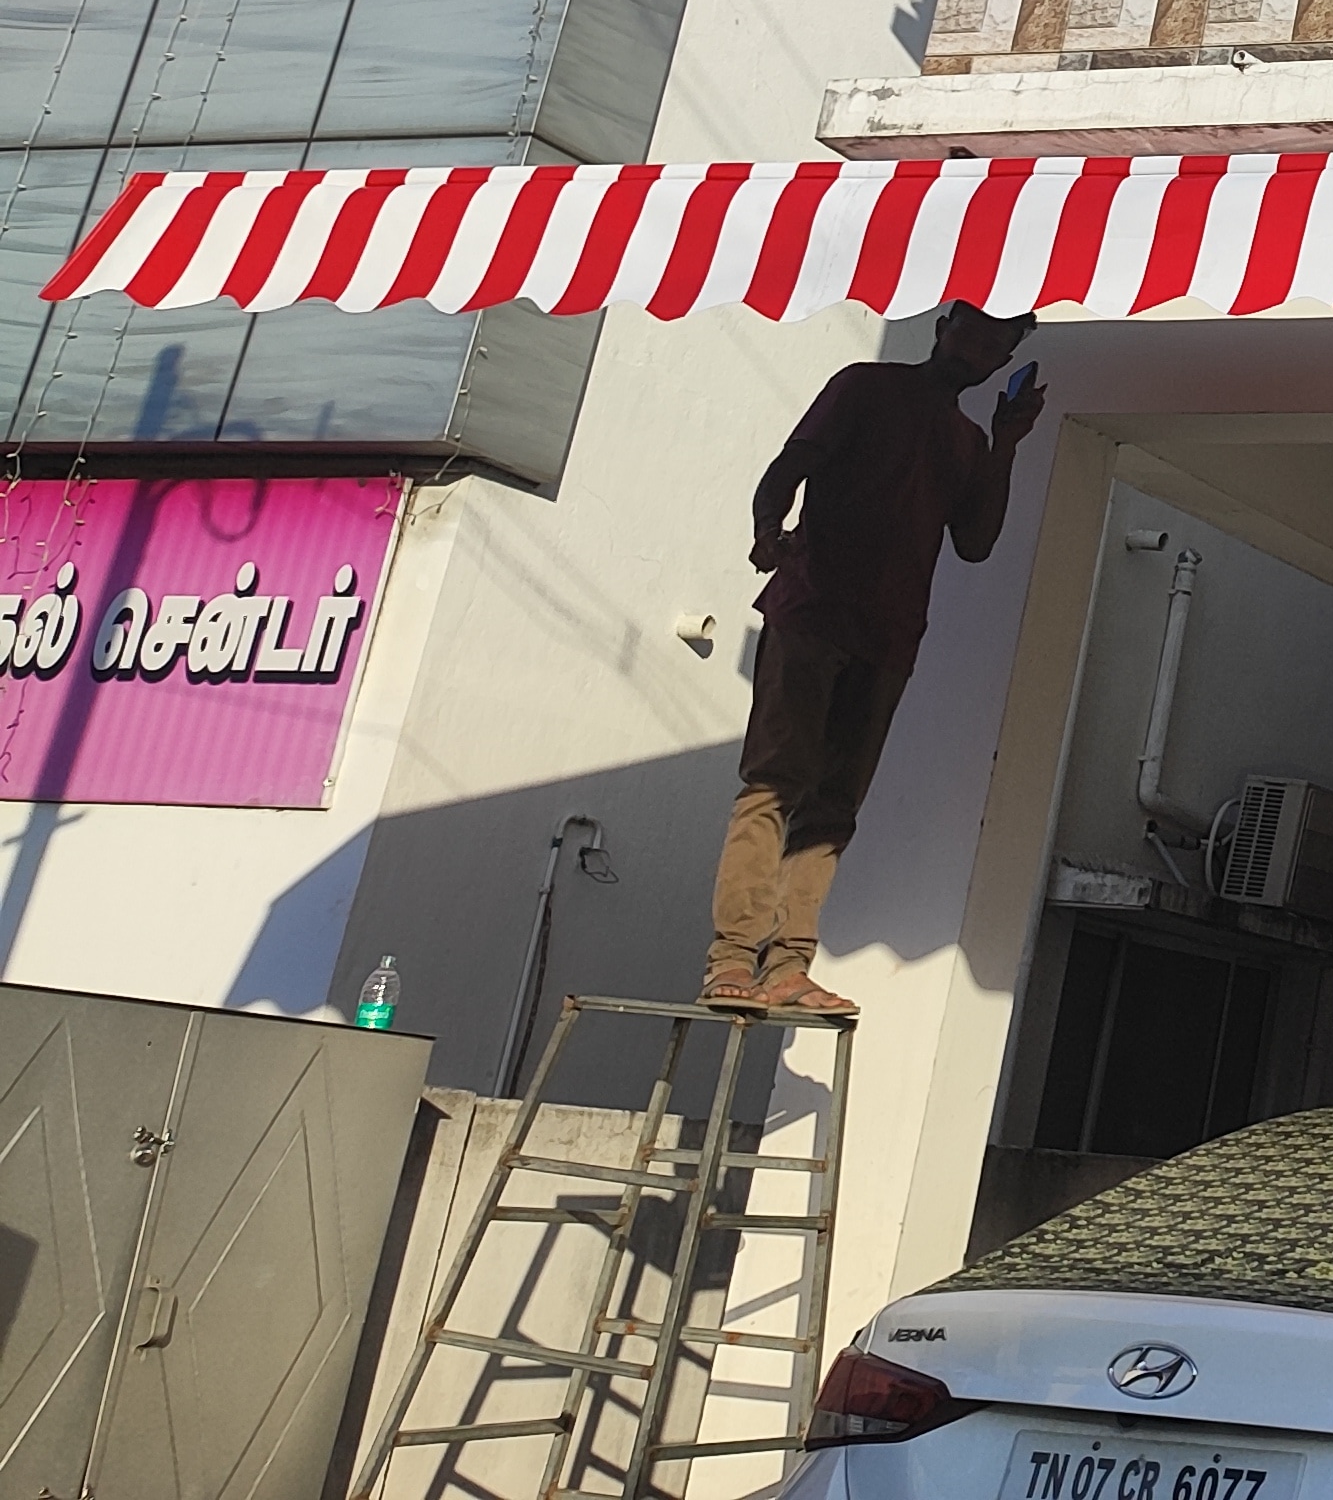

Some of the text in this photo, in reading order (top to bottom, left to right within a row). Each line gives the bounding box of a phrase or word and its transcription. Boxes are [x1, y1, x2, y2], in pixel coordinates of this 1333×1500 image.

[92, 561, 362, 675] சென்டர்
[888, 1327, 946, 1342] VERNA
[1026, 1451, 1071, 1500] TN
[1071, 1455, 1117, 1500] 07
[1172, 1464, 1268, 1500] 6077
